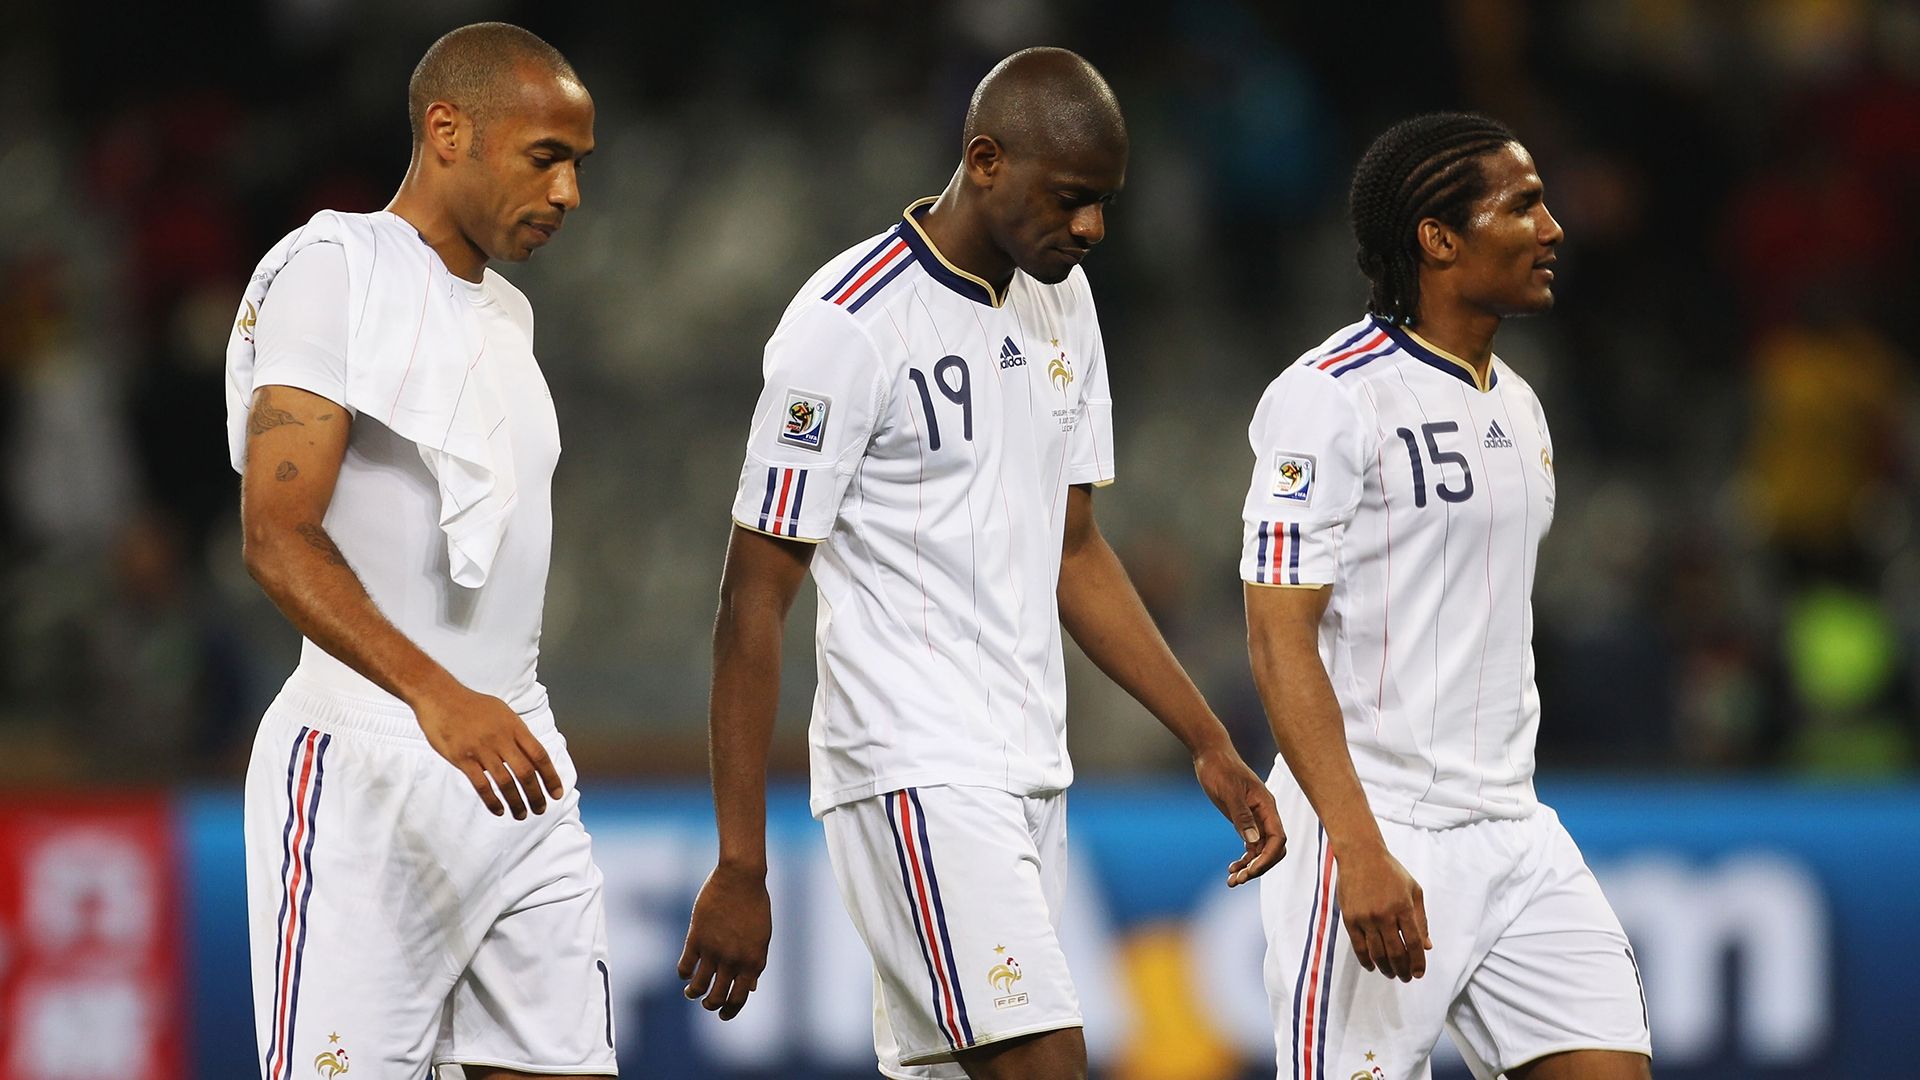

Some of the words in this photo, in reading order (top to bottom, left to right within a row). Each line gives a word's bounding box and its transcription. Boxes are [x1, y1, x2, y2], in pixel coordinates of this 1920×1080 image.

[1000, 355, 1027, 370] didas
[908, 354, 973, 452] 19
[1483, 437, 1513, 449] adidas
[1395, 420, 1475, 509] 15
[997, 995, 1026, 1007] FFF
